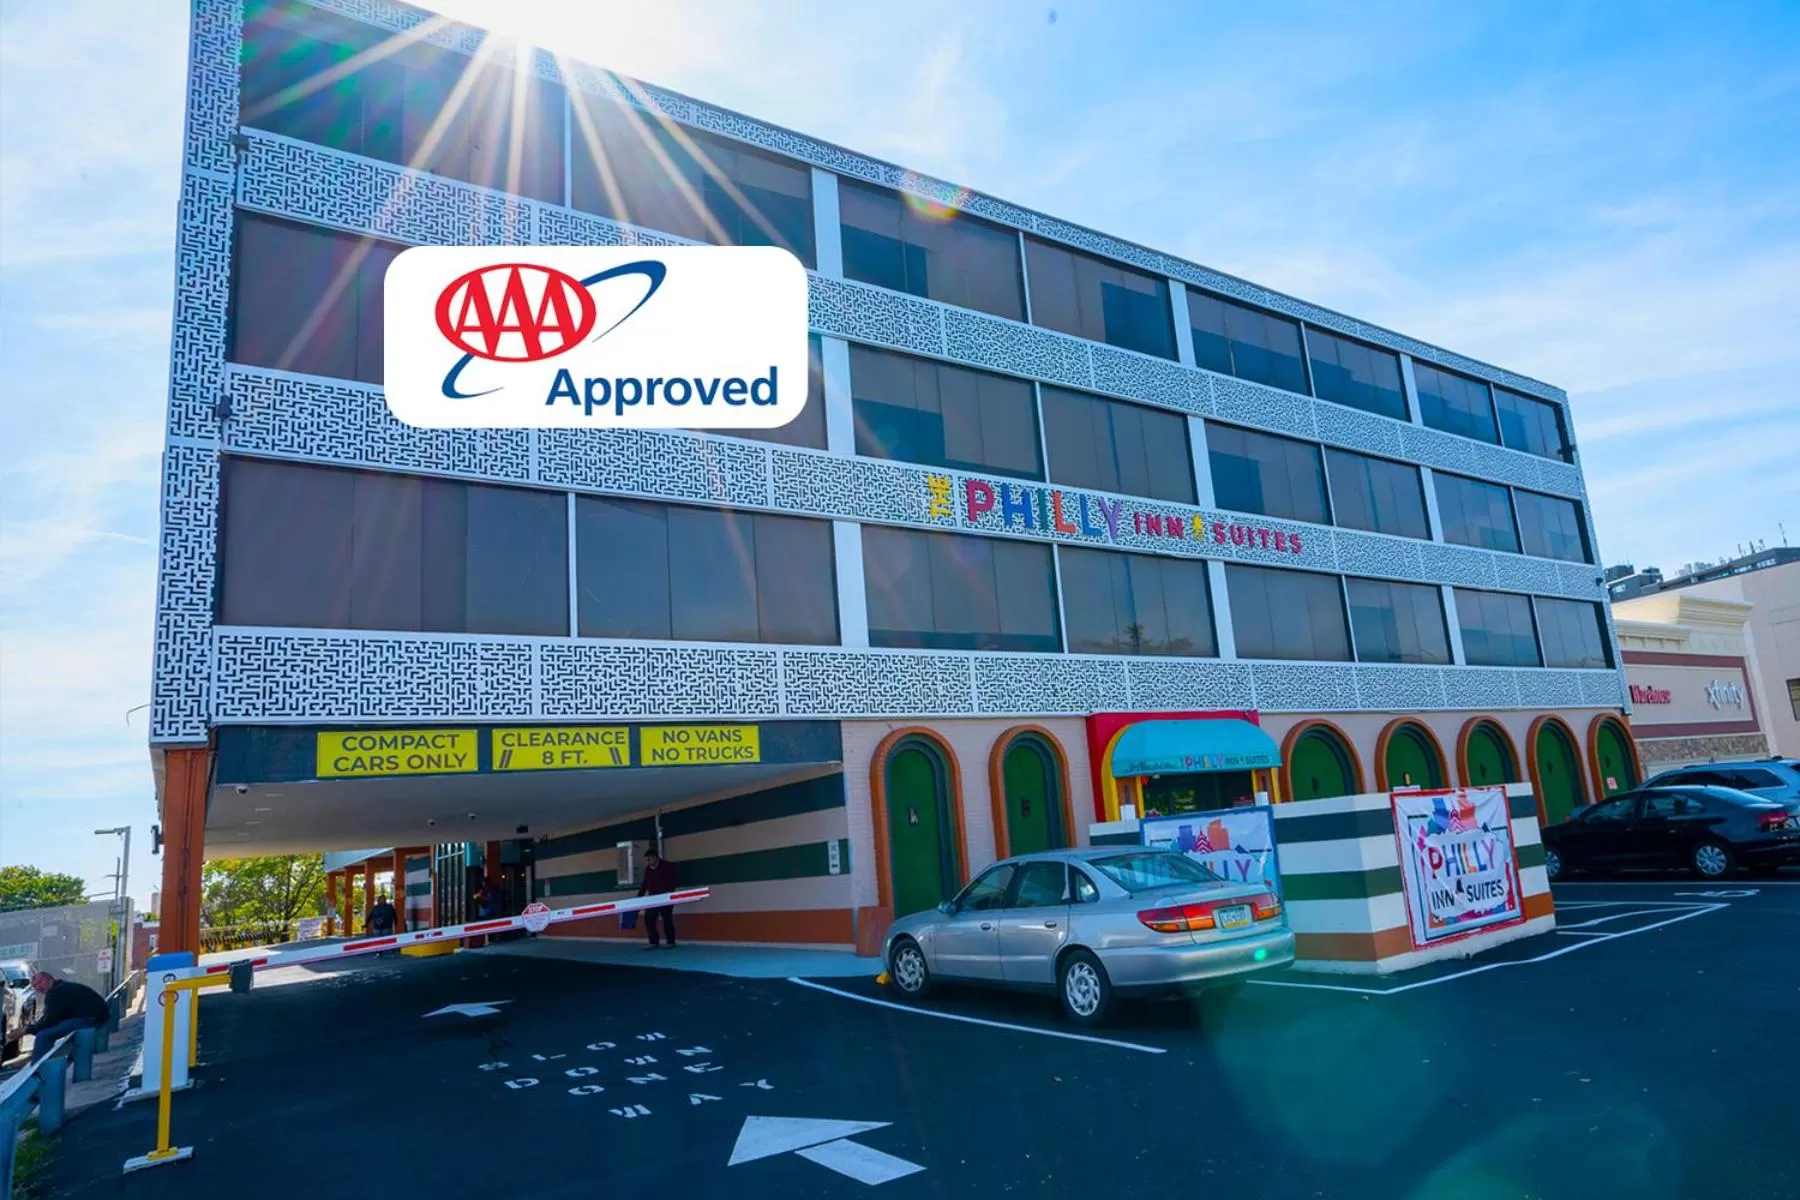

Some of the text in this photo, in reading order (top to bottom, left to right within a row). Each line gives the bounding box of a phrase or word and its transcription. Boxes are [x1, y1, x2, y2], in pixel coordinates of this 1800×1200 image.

[927, 473, 952, 520] THE
[966, 479, 1304, 555] PHILLY INN SUITES
[342, 734, 460, 751] COMPACT
[501, 731, 626, 748] CLEARANCE
[663, 729, 743, 744] NO VANS
[333, 752, 468, 773] CARS ONLY
[541, 750, 588, 766] 8 FT.
[651, 745, 755, 762] NO TRUCKS
[1428, 837, 1495, 879] PHILLY
[1431, 880, 1504, 909] INN SUITES
